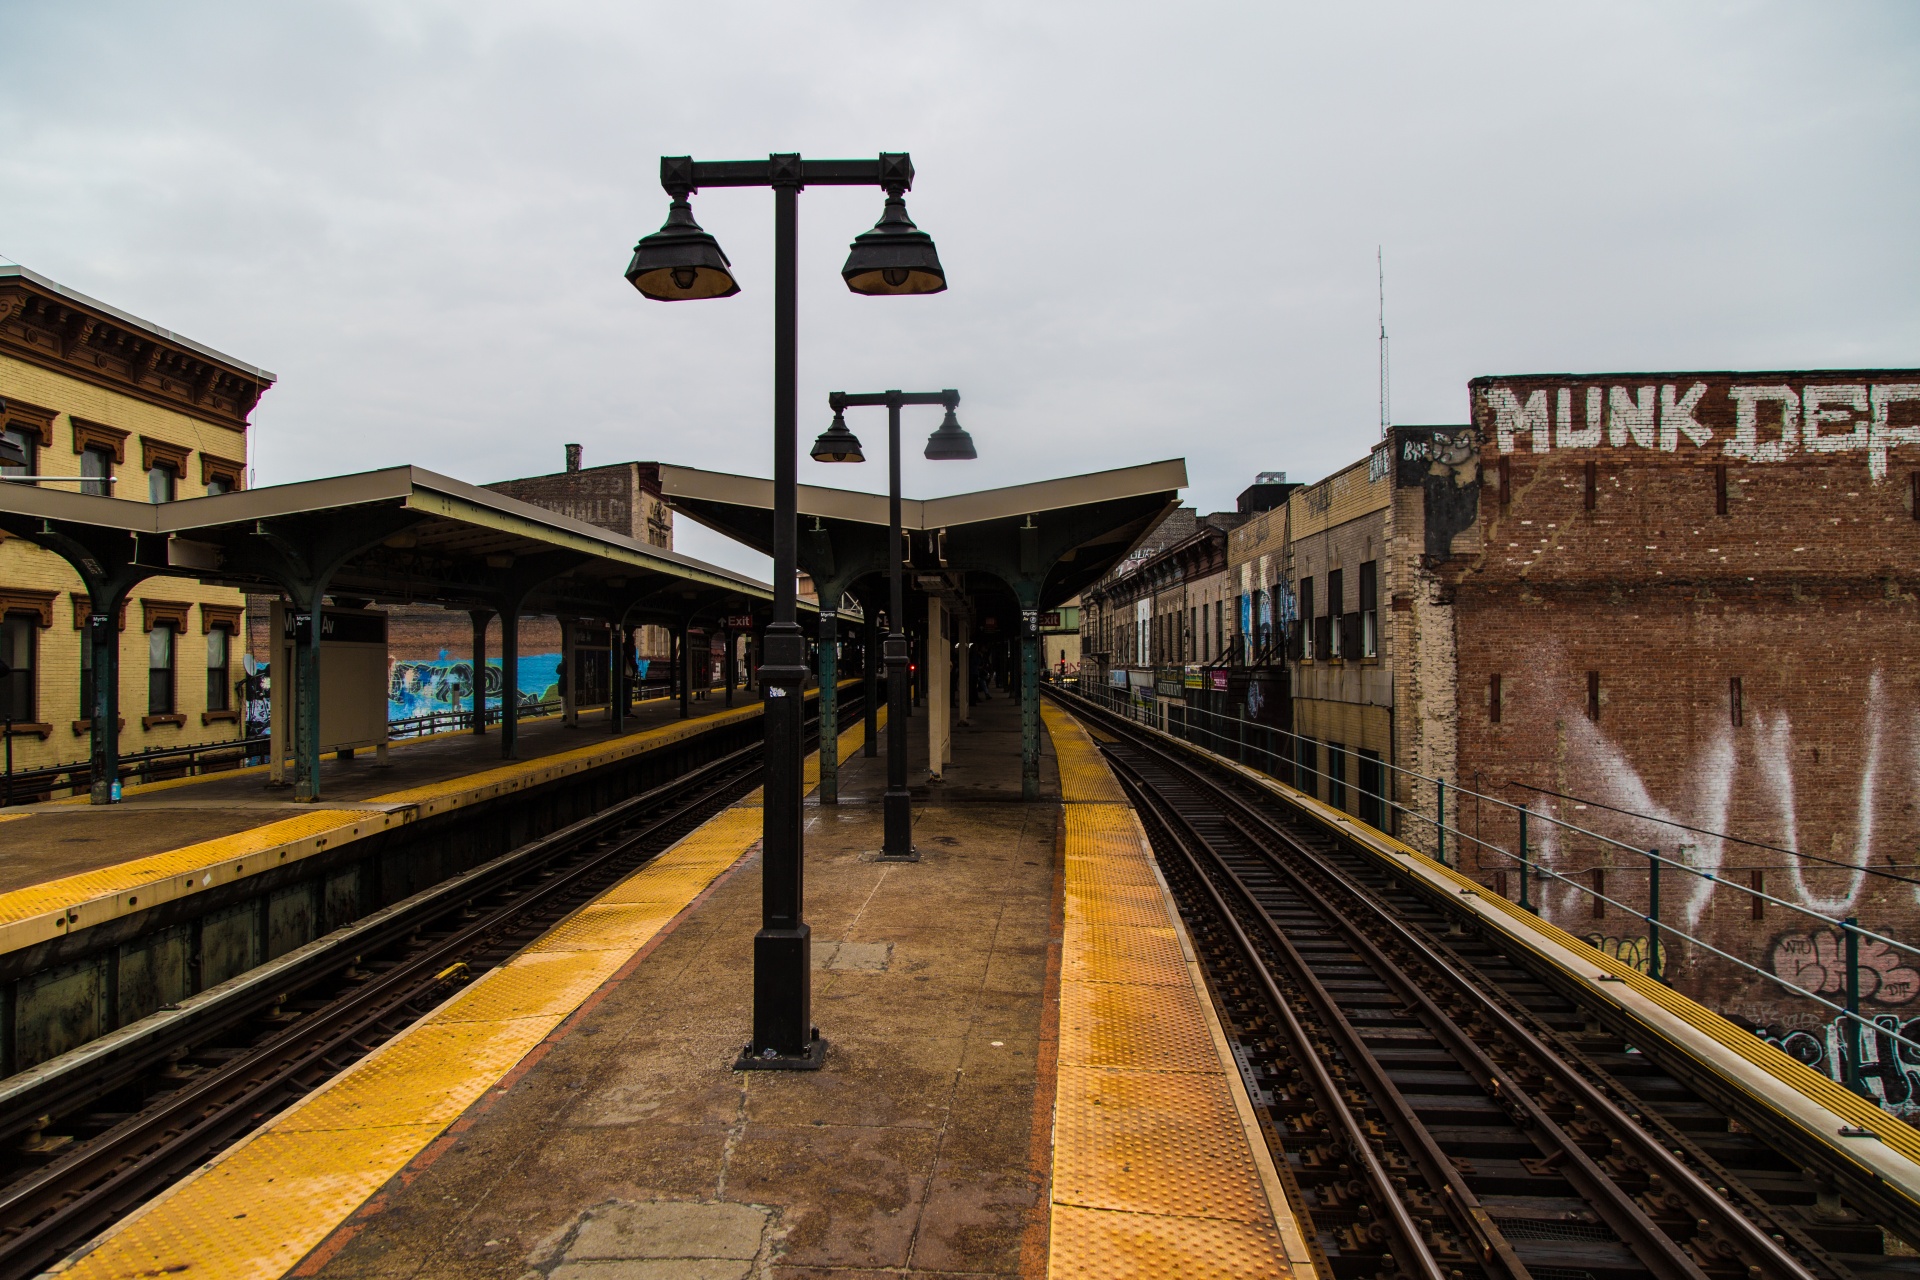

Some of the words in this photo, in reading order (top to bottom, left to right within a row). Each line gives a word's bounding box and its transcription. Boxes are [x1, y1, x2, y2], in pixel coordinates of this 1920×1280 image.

[1484, 381, 1714, 454] MUNK
[321, 615, 334, 634] Av
[728, 615, 750, 626] Exit
